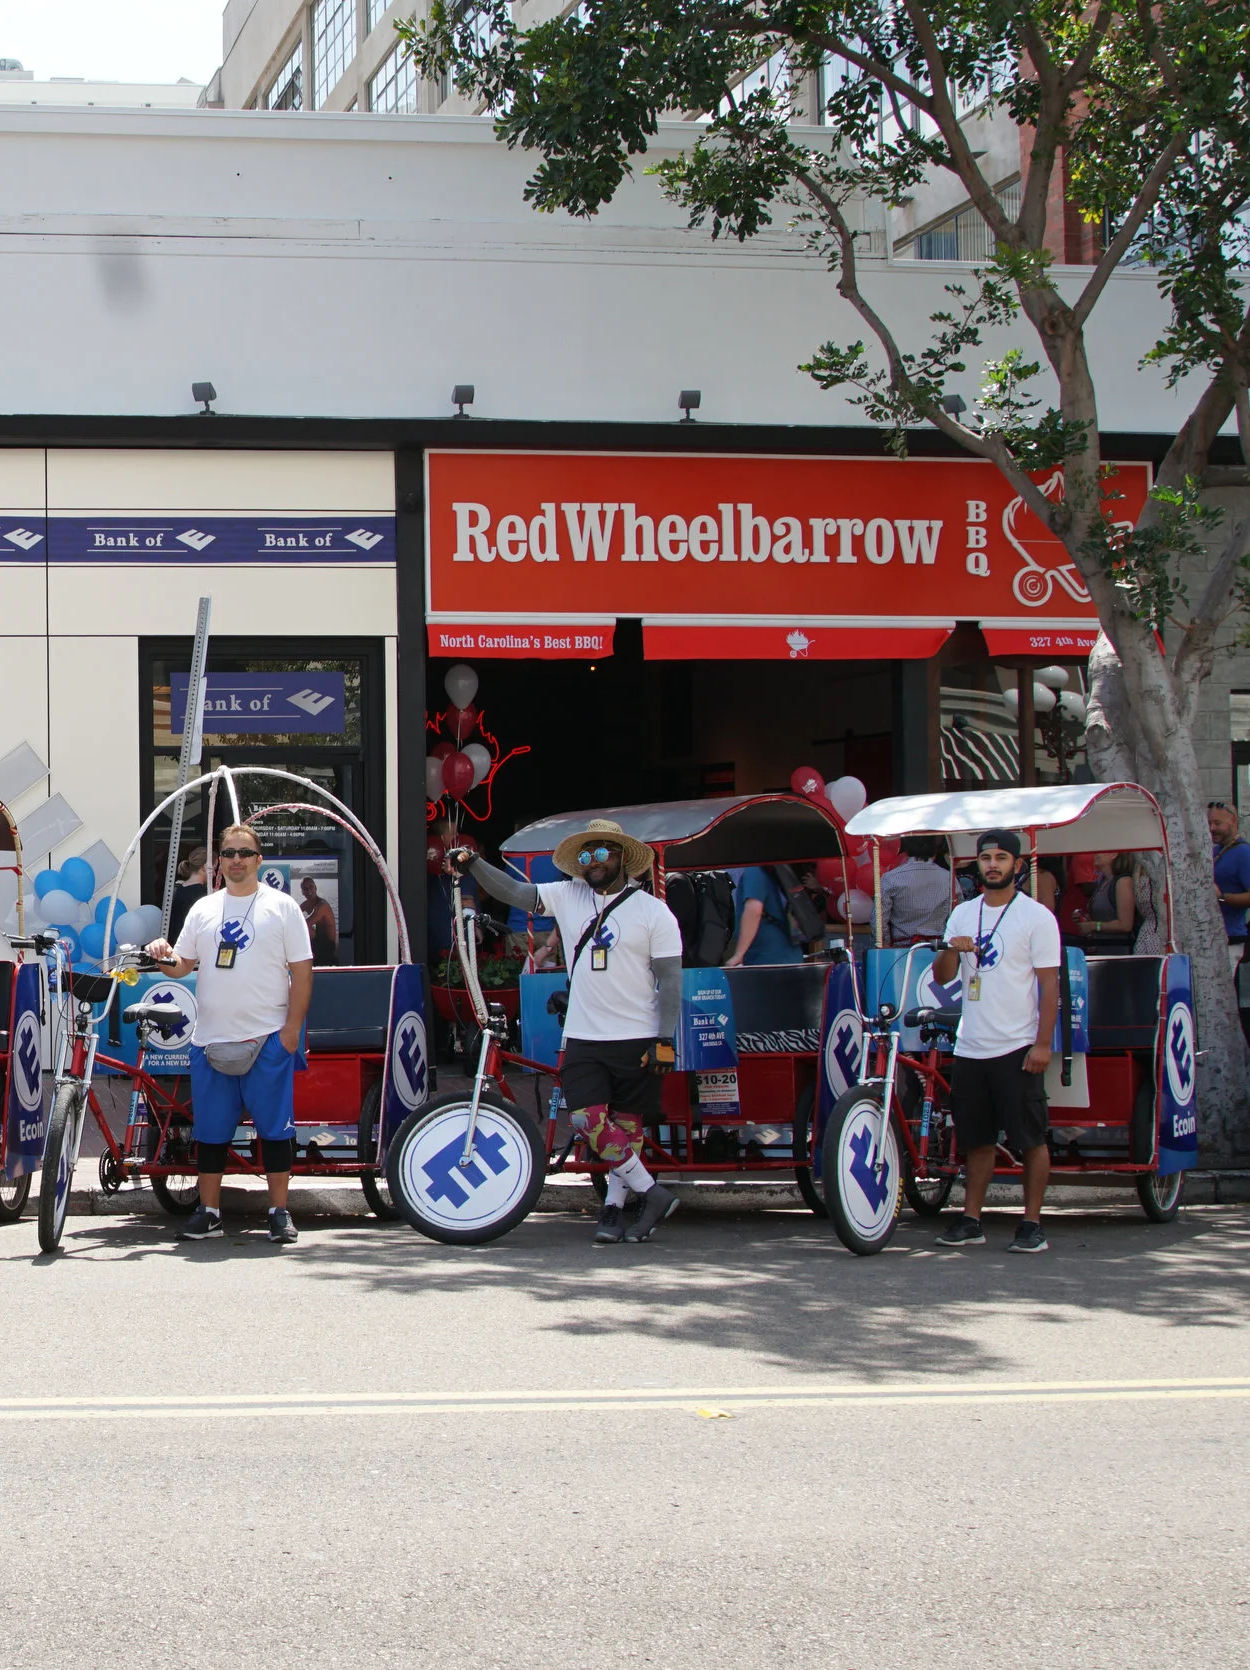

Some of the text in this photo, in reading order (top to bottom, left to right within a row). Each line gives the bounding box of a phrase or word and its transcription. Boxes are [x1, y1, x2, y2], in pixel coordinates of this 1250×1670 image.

[93, 532, 140, 547] Bank
[145, 532, 164, 547] of
[264, 532, 310, 547] Bank
[314, 532, 333, 547] of
[440, 634, 604, 651] North Carolina's Best BBQ!
[1029, 636, 1051, 648] 327
[1055, 636, 1074, 646] 4th
[203, 694, 243, 711] ank
[249, 694, 272, 711] of
[693, 1016, 708, 1026] Bank
[698, 1032, 708, 1041] 327
[695, 1074, 737, 1086] $10-20
[18, 1115, 45, 1143] Ecoin
[1172, 1110, 1196, 1138] Ecoin
